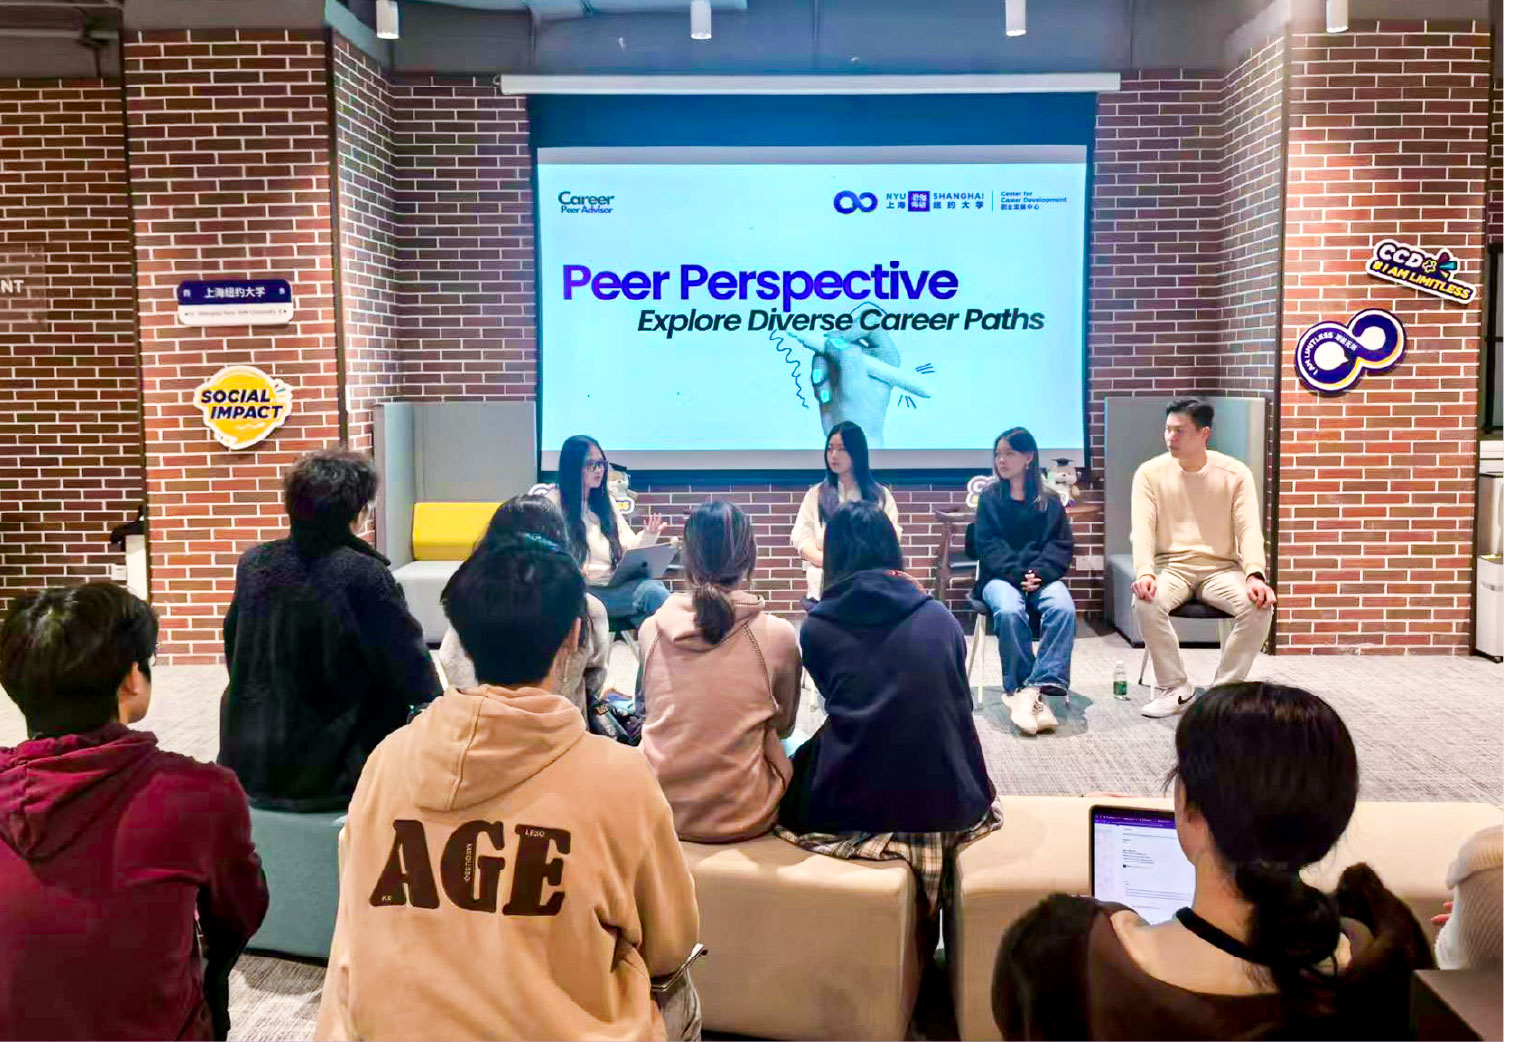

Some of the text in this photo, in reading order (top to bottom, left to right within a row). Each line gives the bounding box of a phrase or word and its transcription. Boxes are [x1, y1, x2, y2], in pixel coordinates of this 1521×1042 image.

[558, 191, 615, 205] Career
[561, 205, 613, 213] Peer Advisor
[1379, 244, 1424, 268] CCD
[563, 260, 959, 312] Peer Perspective
[1388, 267, 1410, 280] AM
[1409, 272, 1471, 299] LIMITLESS
[637, 308, 1046, 339] Explore Diverse Career Paths
[1303, 331, 1334, 358] LIMITLESS
[201, 389, 271, 403] SOCIAL
[210, 405, 283, 419] IMPACT
[369, 820, 571, 916] AGE
